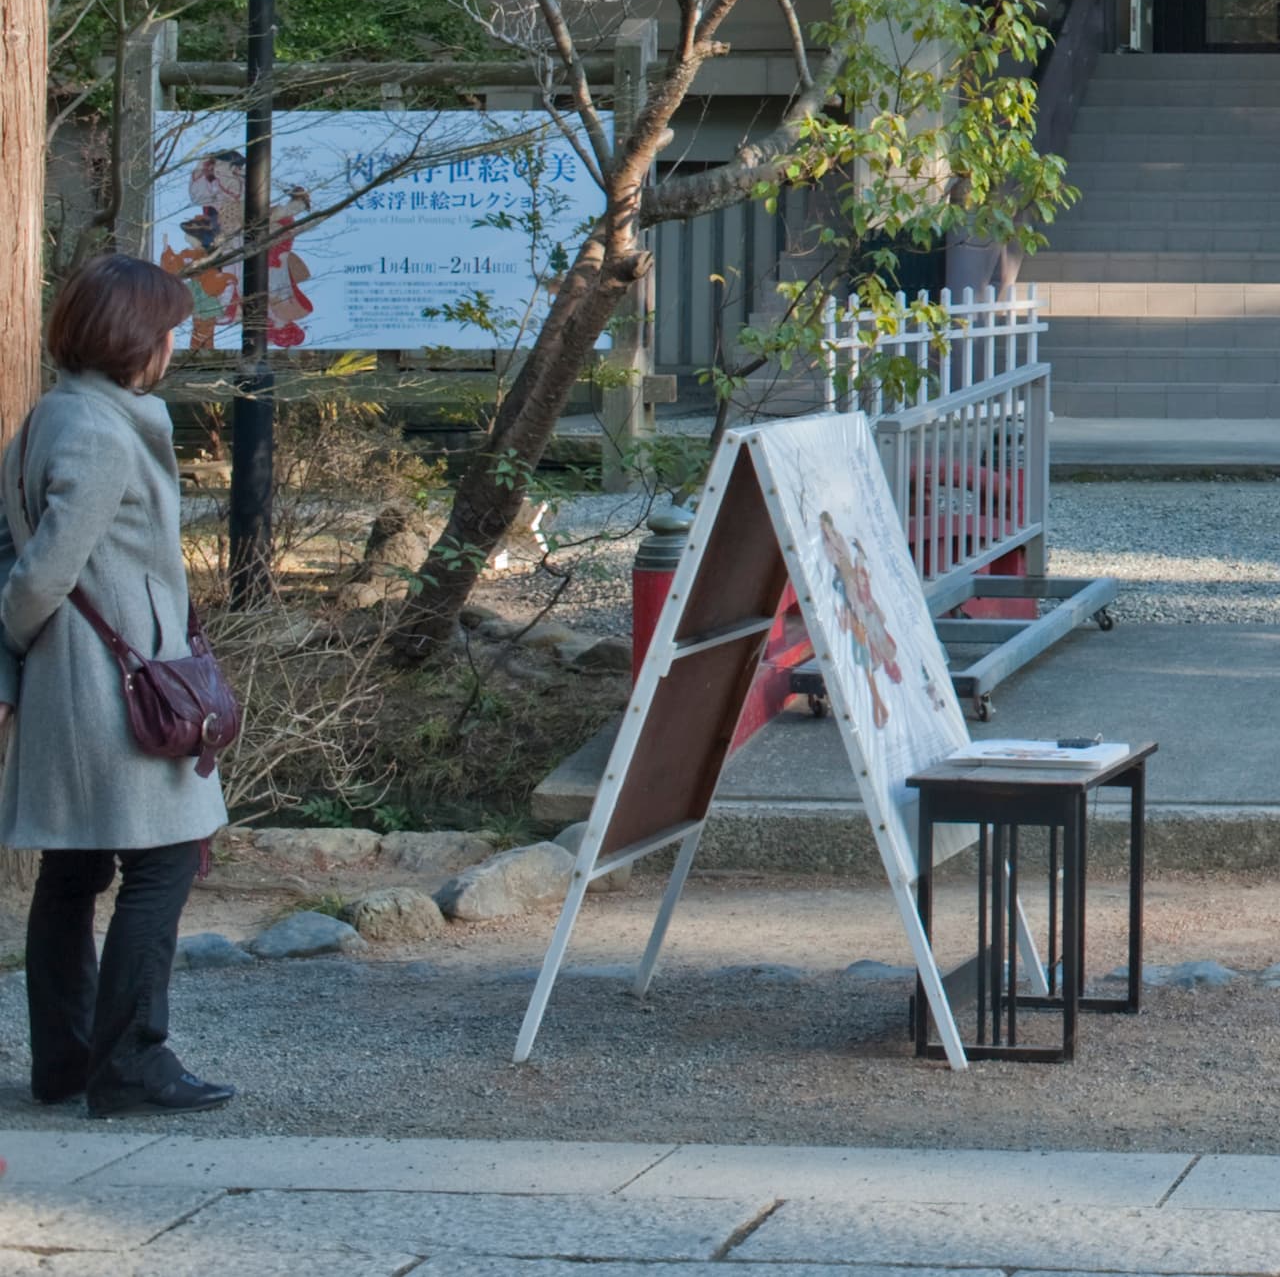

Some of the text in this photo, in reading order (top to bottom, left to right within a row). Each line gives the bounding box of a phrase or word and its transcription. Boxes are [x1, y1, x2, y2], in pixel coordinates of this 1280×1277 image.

[346, 153, 577, 184] 肉浮世絵の美
